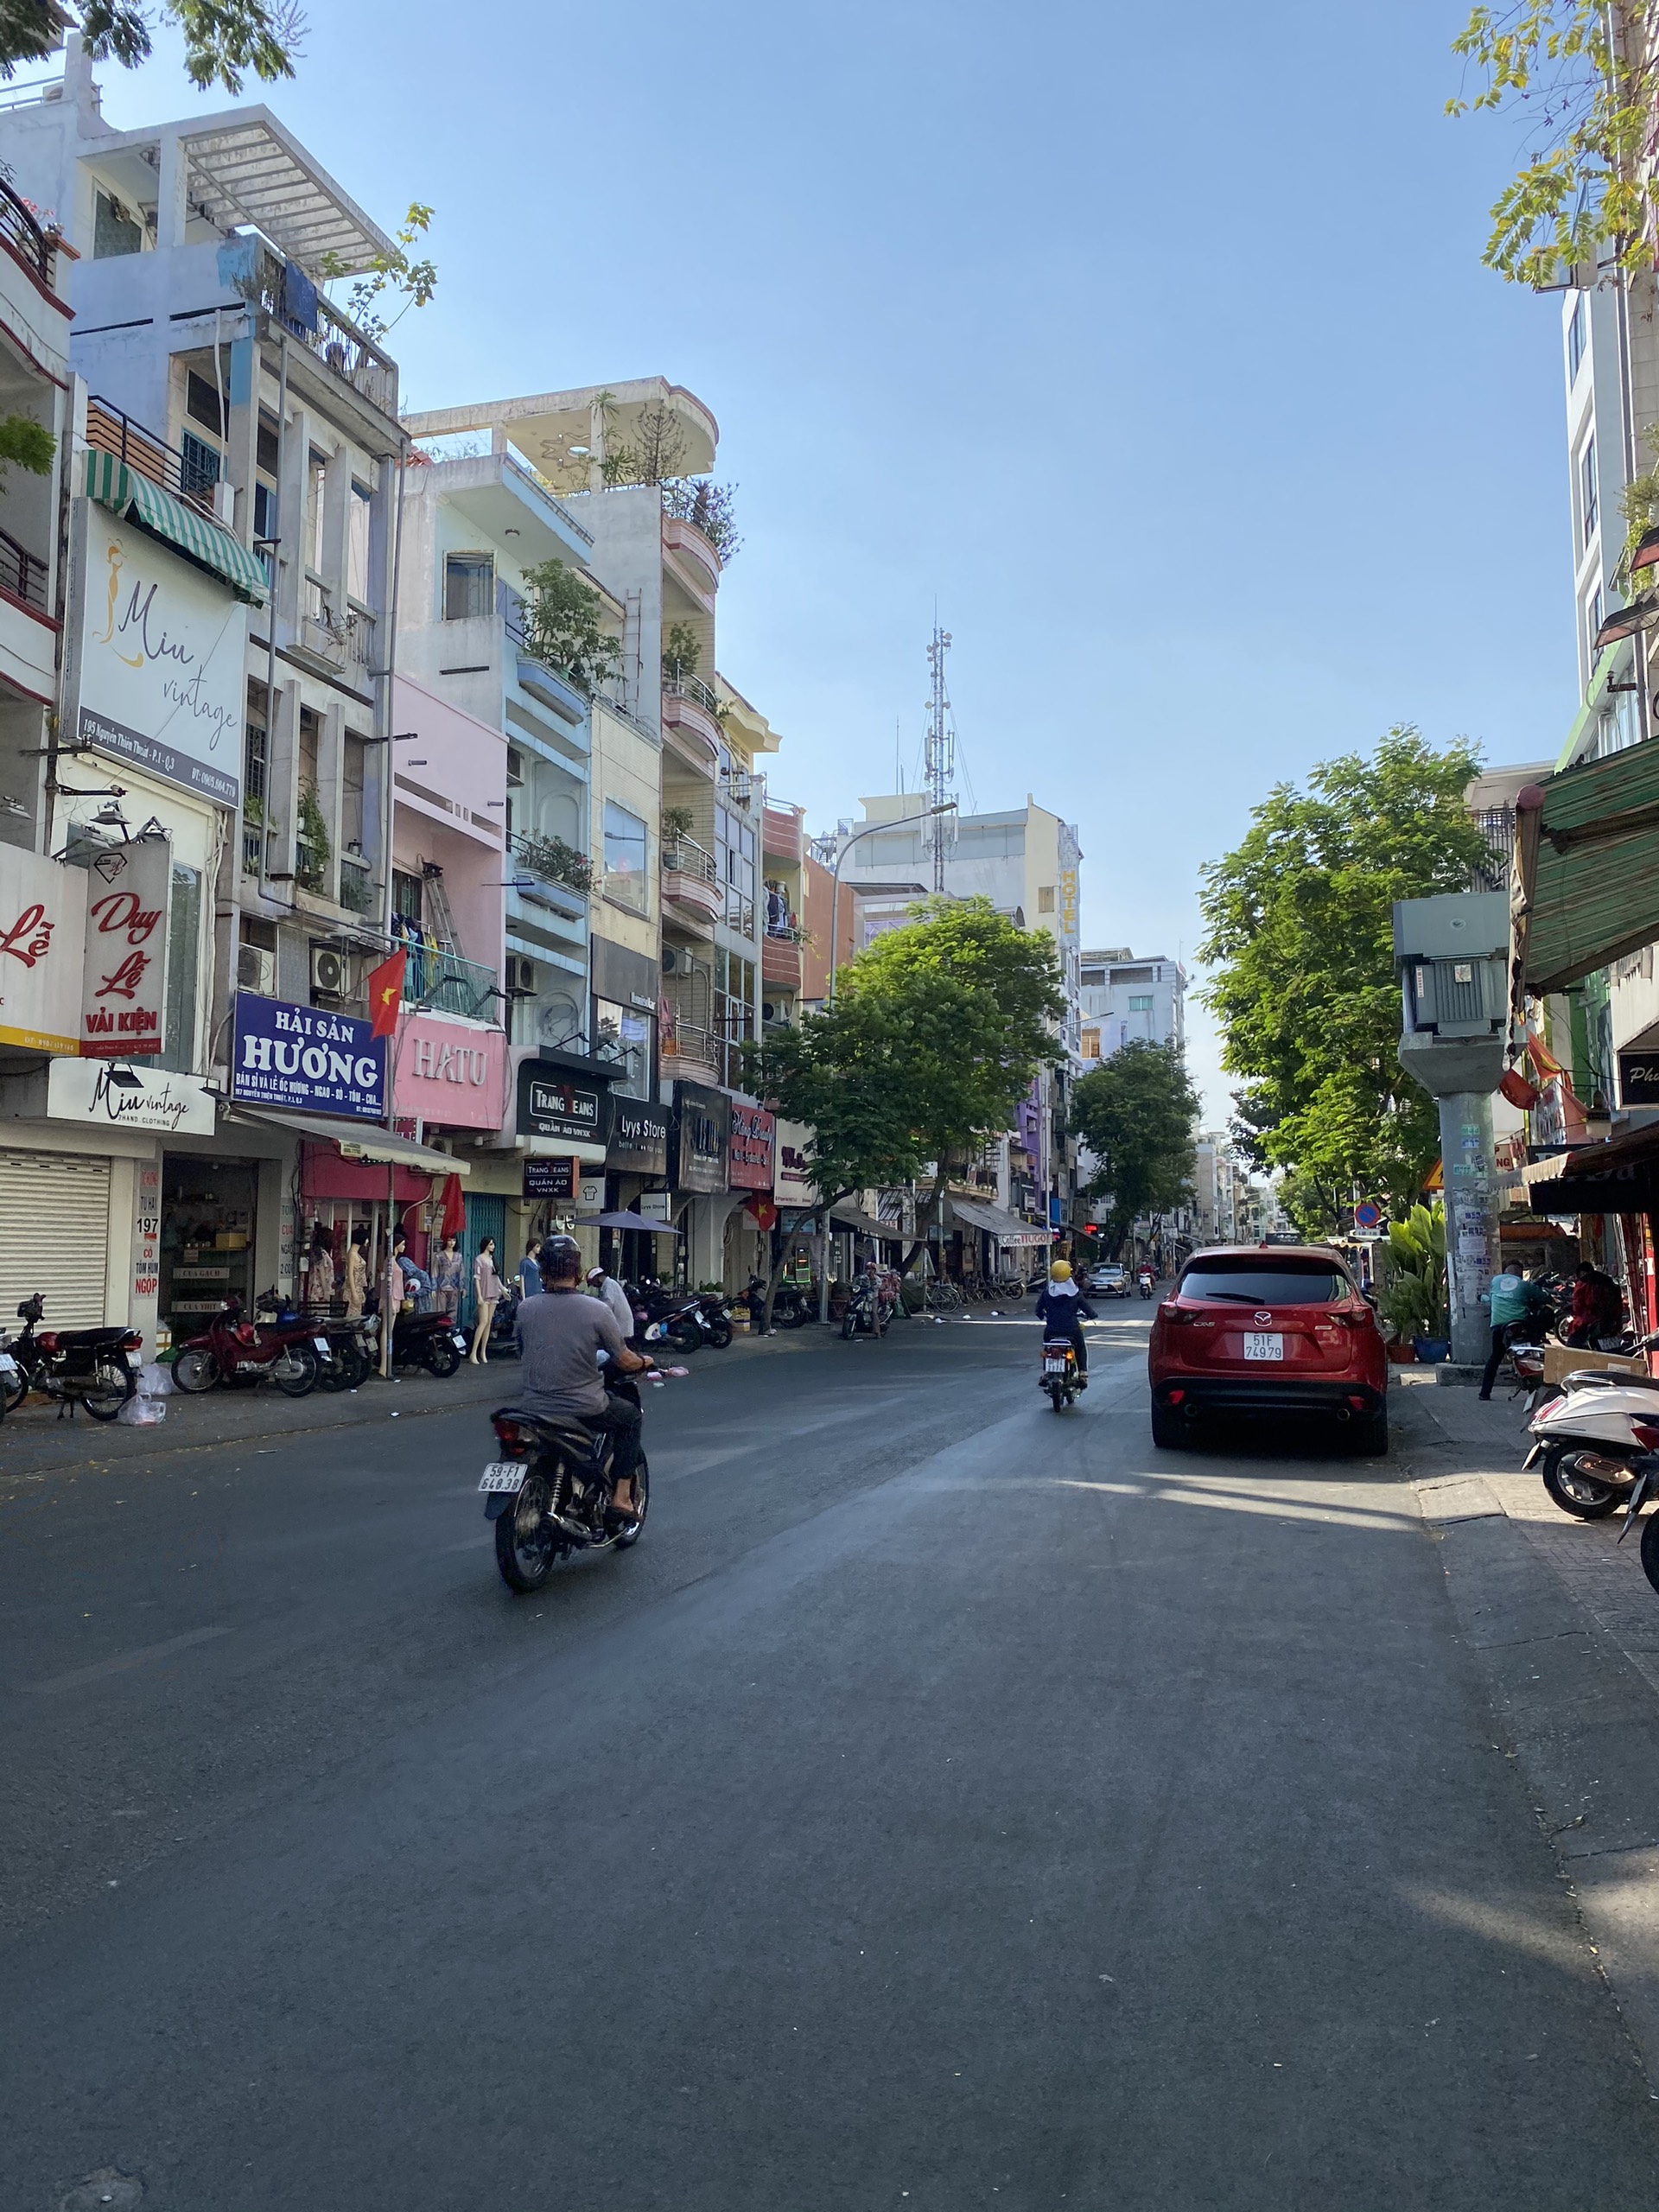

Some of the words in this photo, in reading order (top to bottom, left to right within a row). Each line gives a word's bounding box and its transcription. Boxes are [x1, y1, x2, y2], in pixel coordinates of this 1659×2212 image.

[118, 580, 194, 664] Miu
[163, 664, 238, 751] vintage
[83, 718, 96, 734] 195
[1061, 870, 1077, 934] HOTEL
[91, 892, 162, 945] Duy
[86, 1006, 114, 1033] VẢI
[118, 1006, 158, 1036] KIỆN
[275, 1007, 312, 1036] HẢI
[316, 1015, 354, 1044] SẢN
[242, 1034, 378, 1088] HƯƠNG
[412, 1039, 488, 1087] HATU
[88, 1067, 145, 1120] Miu
[235, 1071, 251, 1086] BÁN
[259, 1074, 269, 1090] VÀ
[270, 1075, 278, 1091] LẺ
[279, 1077, 289, 1093] ỐC
[535, 1089, 565, 1112] TRANG
[142, 1118, 170, 1127] CLOTHING
[573, 1128, 591, 1138] VNXK
[621, 1115, 641, 1139] Lyys
[643, 1119, 666, 1140] Store
[137, 1217, 158, 1233] 197
[1253, 1334, 1274, 1346] 51F
[480, 1478, 519, 1490] 648.38
[489, 1465, 520, 1478] 59-F1
